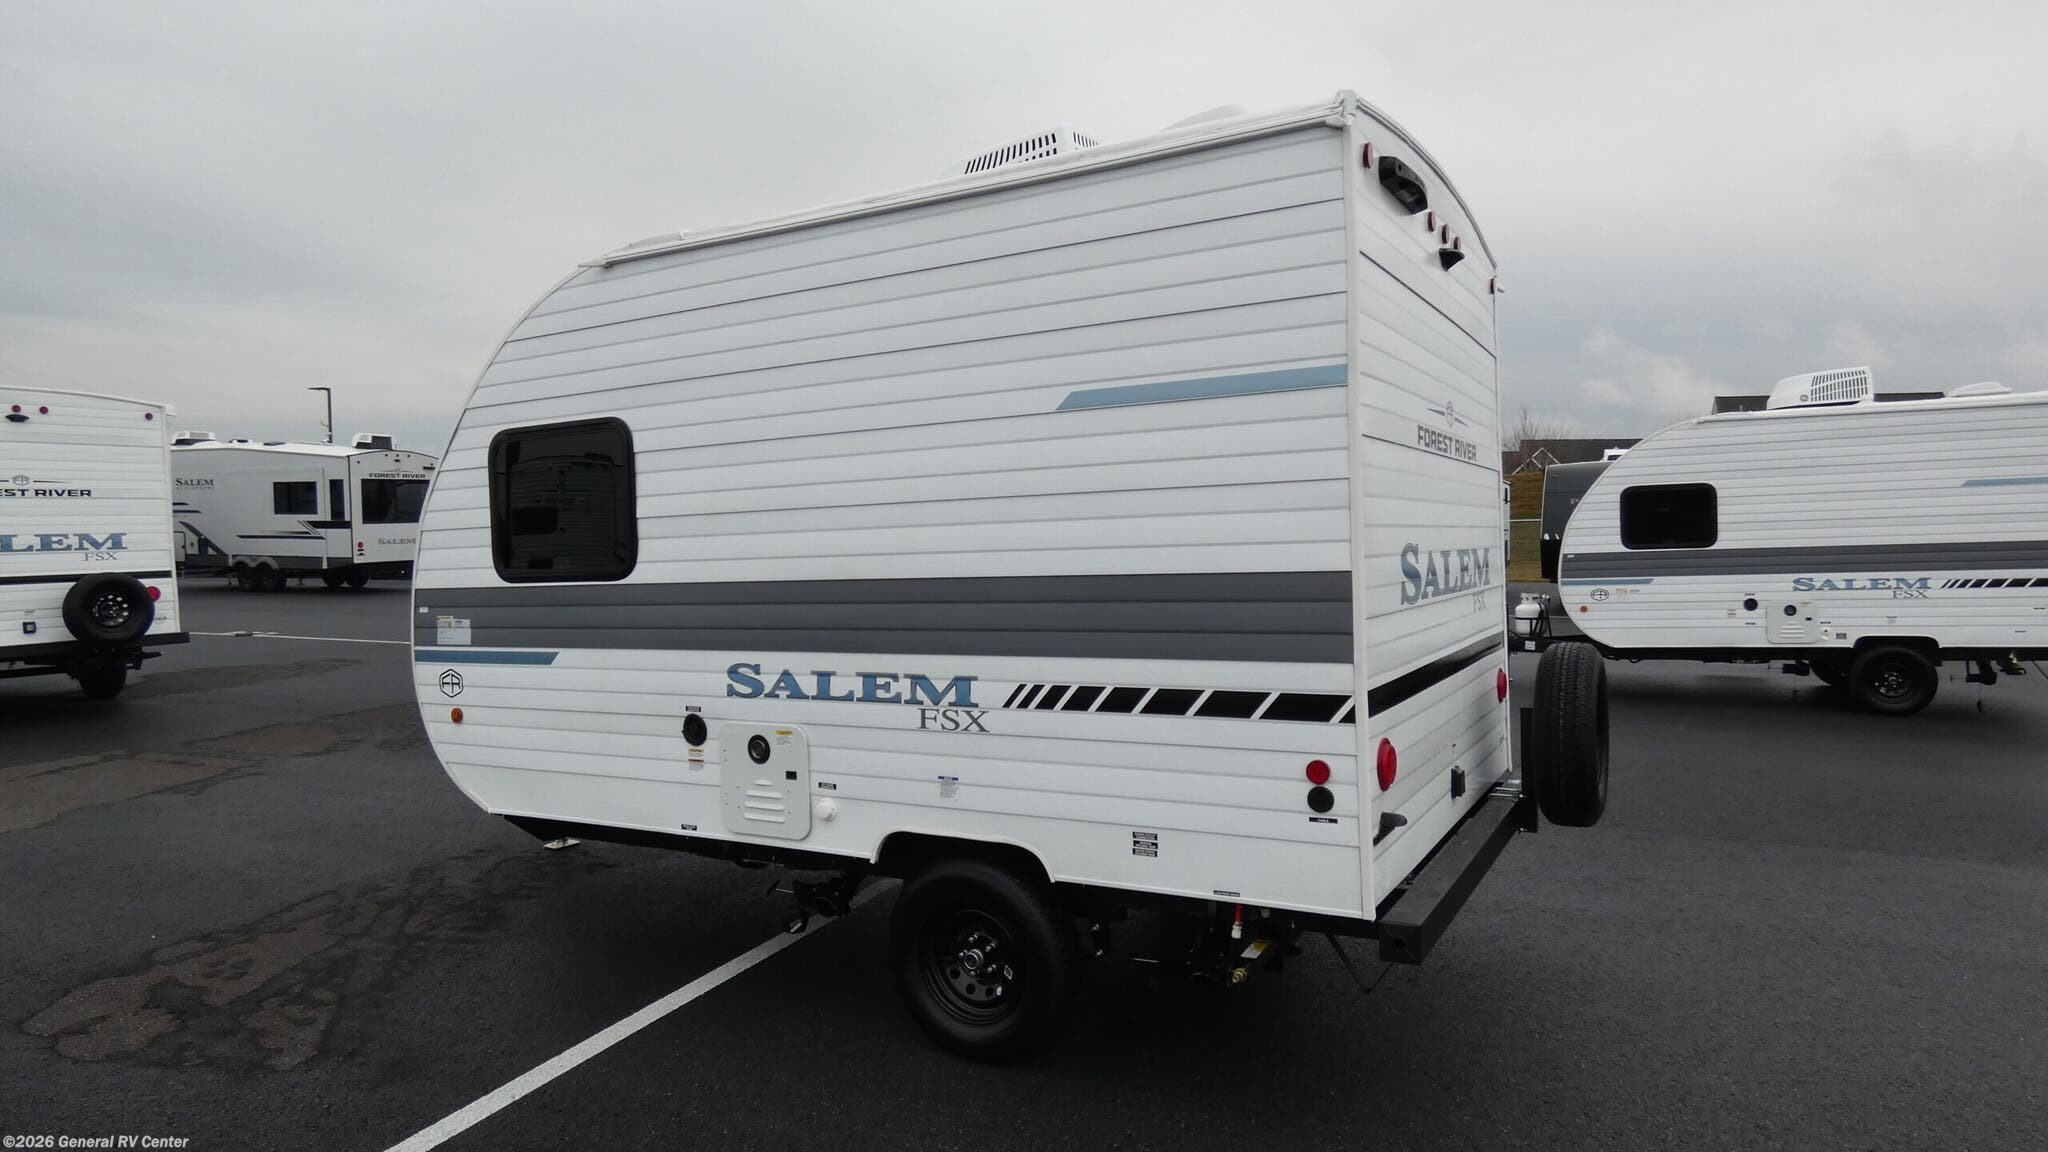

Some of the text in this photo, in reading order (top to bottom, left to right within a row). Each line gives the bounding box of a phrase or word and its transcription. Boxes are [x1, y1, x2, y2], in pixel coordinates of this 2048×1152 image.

[1417, 424, 1477, 462] FOREST RIVER
[175, 477, 215, 487] SALEM
[34, 489, 92, 497] RIVER
[82, 551, 119, 561] FSX
[1400, 543, 1490, 605] SALEM
[1792, 577, 1932, 592] SALEM
[1892, 590, 1929, 600] FSX
[726, 662, 979, 708] SALEM
[917, 707, 990, 733] FSX
